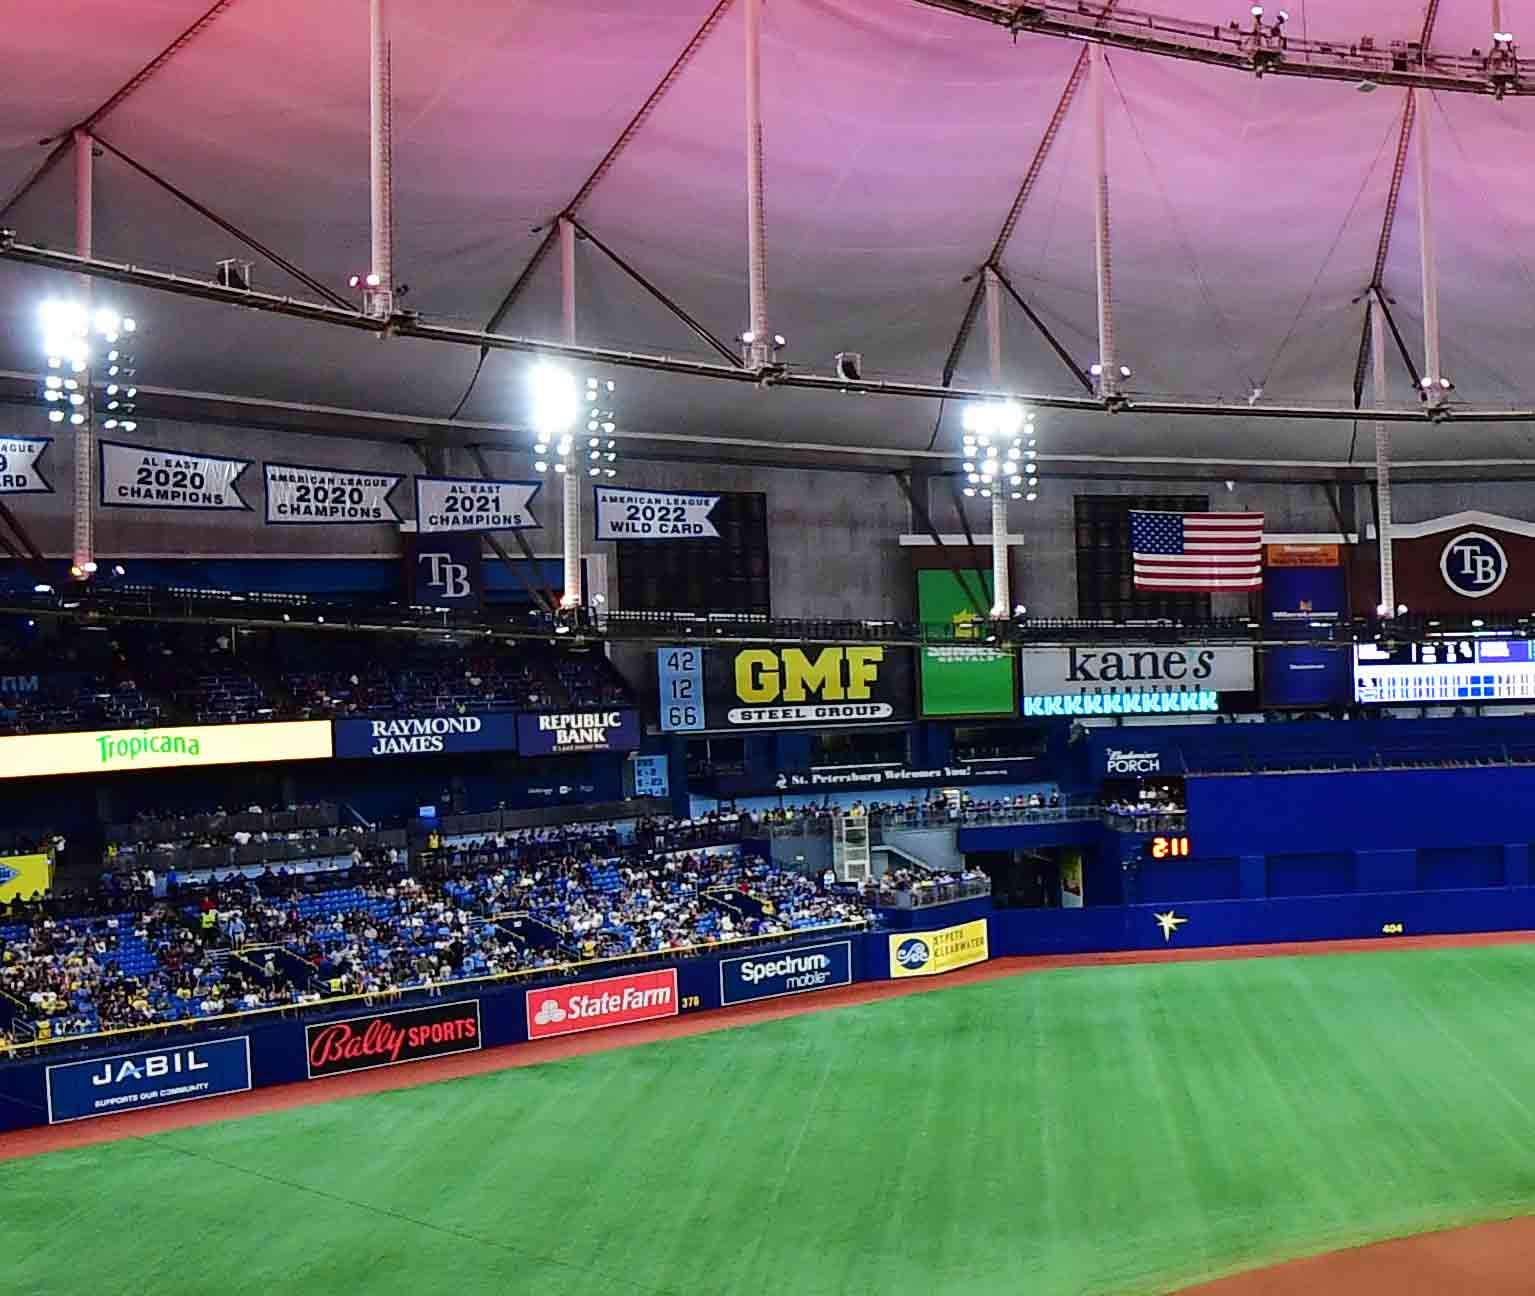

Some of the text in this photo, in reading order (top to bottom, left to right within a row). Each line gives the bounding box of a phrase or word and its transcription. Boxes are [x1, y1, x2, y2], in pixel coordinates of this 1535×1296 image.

[142, 456, 200, 471] AL EAST
[136, 468, 205, 489] 2020
[270, 474, 388, 488] AMERICAN LEAGUE
[118, 486, 224, 505] CHAMPIONS
[296, 487, 363, 505] 2020
[450, 485, 501, 494] AL EAST
[445, 496, 501, 513] 2021
[601, 495, 711, 507] AMERICAN LEAGUE
[277, 503, 382, 519] CHAMPIONS
[428, 514, 522, 526] CHAMPIONS
[626, 505, 687, 523] 2022
[610, 521, 704, 535] WILD CARD
[1453, 545, 1497, 584] TB
[418, 553, 471, 599] TB
[667, 651, 695, 671] 42
[734, 647, 884, 703] GMF
[671, 679, 693, 699] 12
[539, 712, 621, 730] REPUBLIC
[669, 707, 697, 727] 66
[740, 704, 882, 722] STEEL GROUP
[371, 716, 481, 737] RAYMOND
[556, 728, 606, 744] BANK
[96, 729, 200, 763] Tropicana
[372, 735, 444, 755] JAMES
[1107, 760, 1160, 773] PORCH
[741, 953, 826, 983] Spectrum
[786, 971, 826, 990] mobile
[311, 1017, 476, 1069] Bally SPORTS
[93, 1051, 208, 1087] JABIL
[95, 1082, 209, 1108] SUPPORTS OUR COMMUNITY
